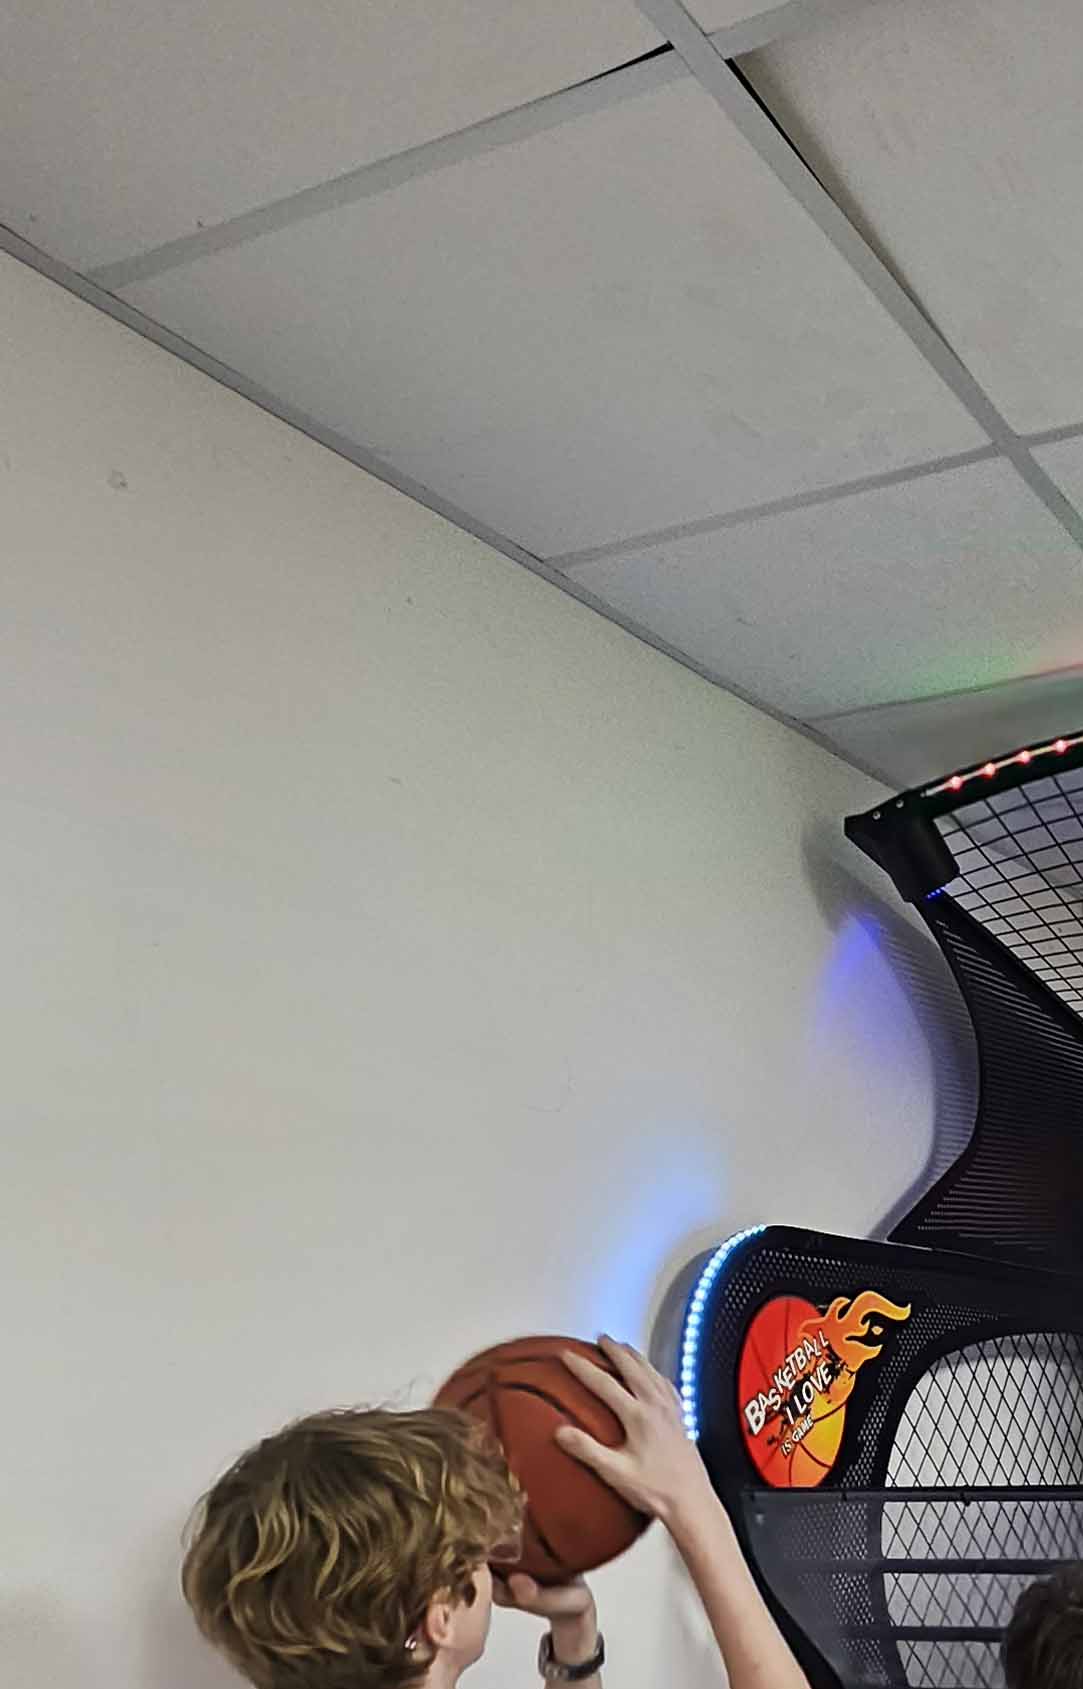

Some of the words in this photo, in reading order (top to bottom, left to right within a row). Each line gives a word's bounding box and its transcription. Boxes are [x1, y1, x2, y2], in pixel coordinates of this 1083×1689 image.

[744, 1328, 830, 1436] BASKETBALL
[785, 1405, 795, 1425] I
[793, 1361, 832, 1415] LOVE
[781, 1440, 793, 1456] IS
[791, 1413, 814, 1442] GAME
